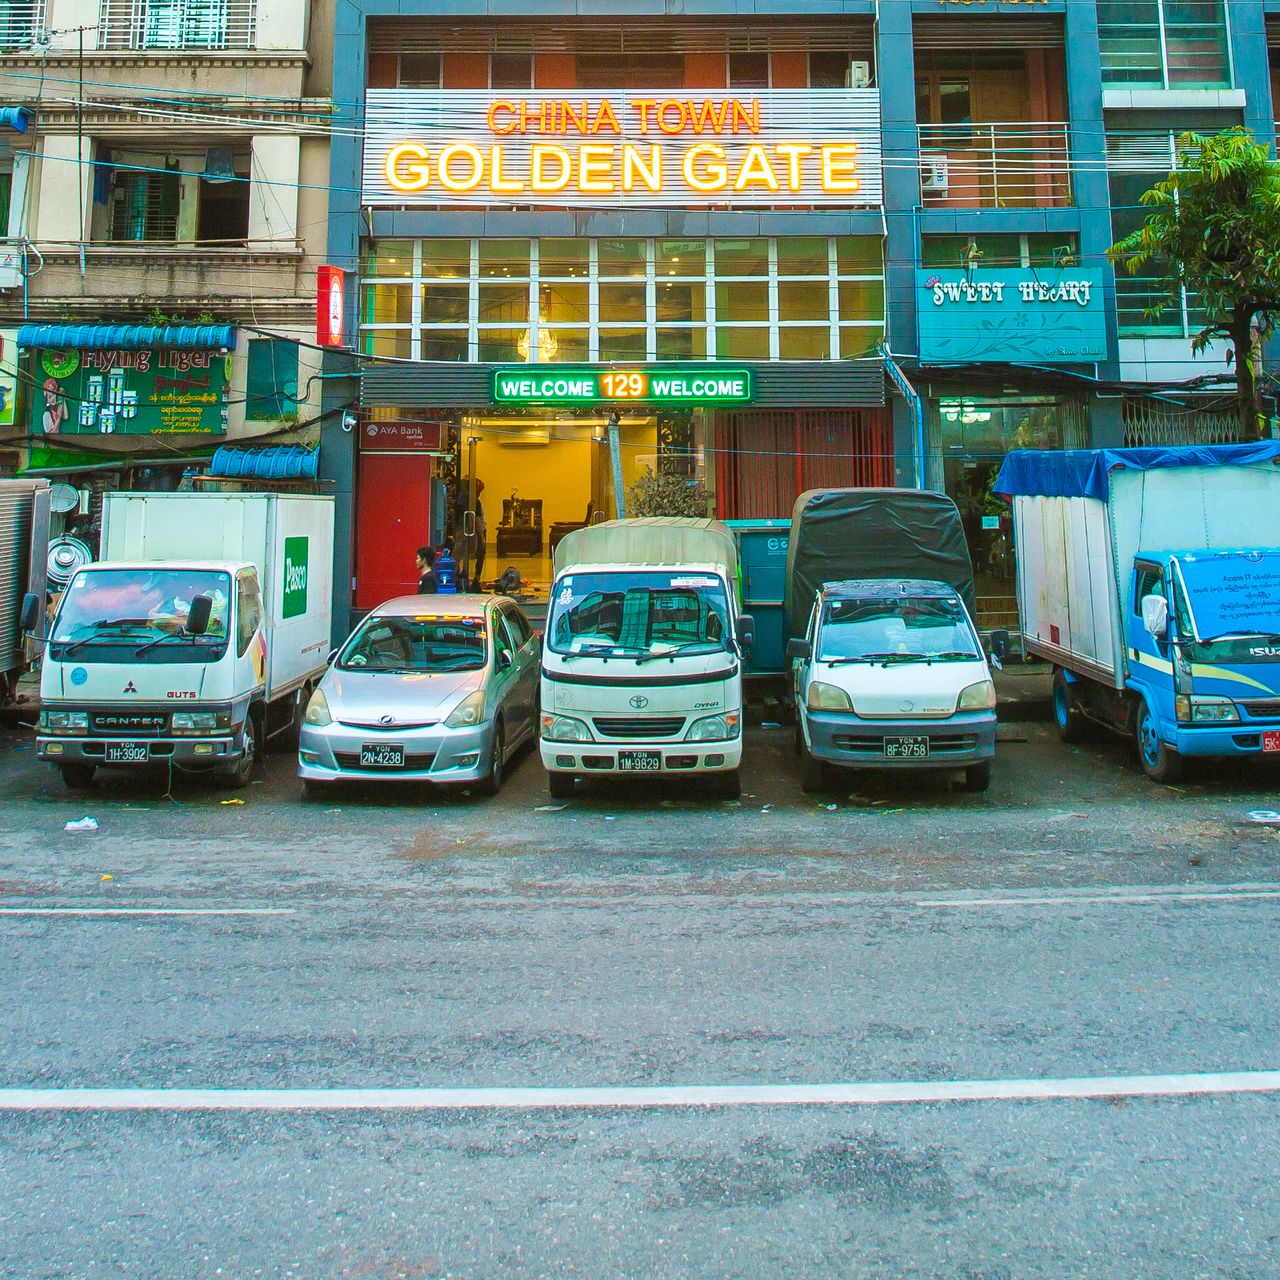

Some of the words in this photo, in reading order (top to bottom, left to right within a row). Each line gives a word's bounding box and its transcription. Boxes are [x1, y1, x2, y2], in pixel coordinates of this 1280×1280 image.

[488, 99, 621, 135] CHINA
[630, 99, 760, 135] TOWN
[384, 142, 664, 192] GOLDEN
[681, 142, 860, 192] GATE
[932, 277, 1006, 306] SWEET
[1019, 280, 1093, 306] HEART
[82, 349, 151, 373] Flying
[158, 349, 214, 372] Tiger
[502, 380, 594, 397] WELCOME
[603, 374, 643, 396] 129
[653, 380, 744, 396] WELCOME
[380, 426, 398, 435] AYA
[400, 426, 423, 435] Bank
[285, 557, 306, 594] Pasco
[95, 717, 164, 725] CANTER
[109, 748, 146, 761] 1H-3902
[362, 751, 401, 765] 2N-4238
[887, 744, 926, 756] 8F-9758
[620, 758, 660, 770] 1M-9829
